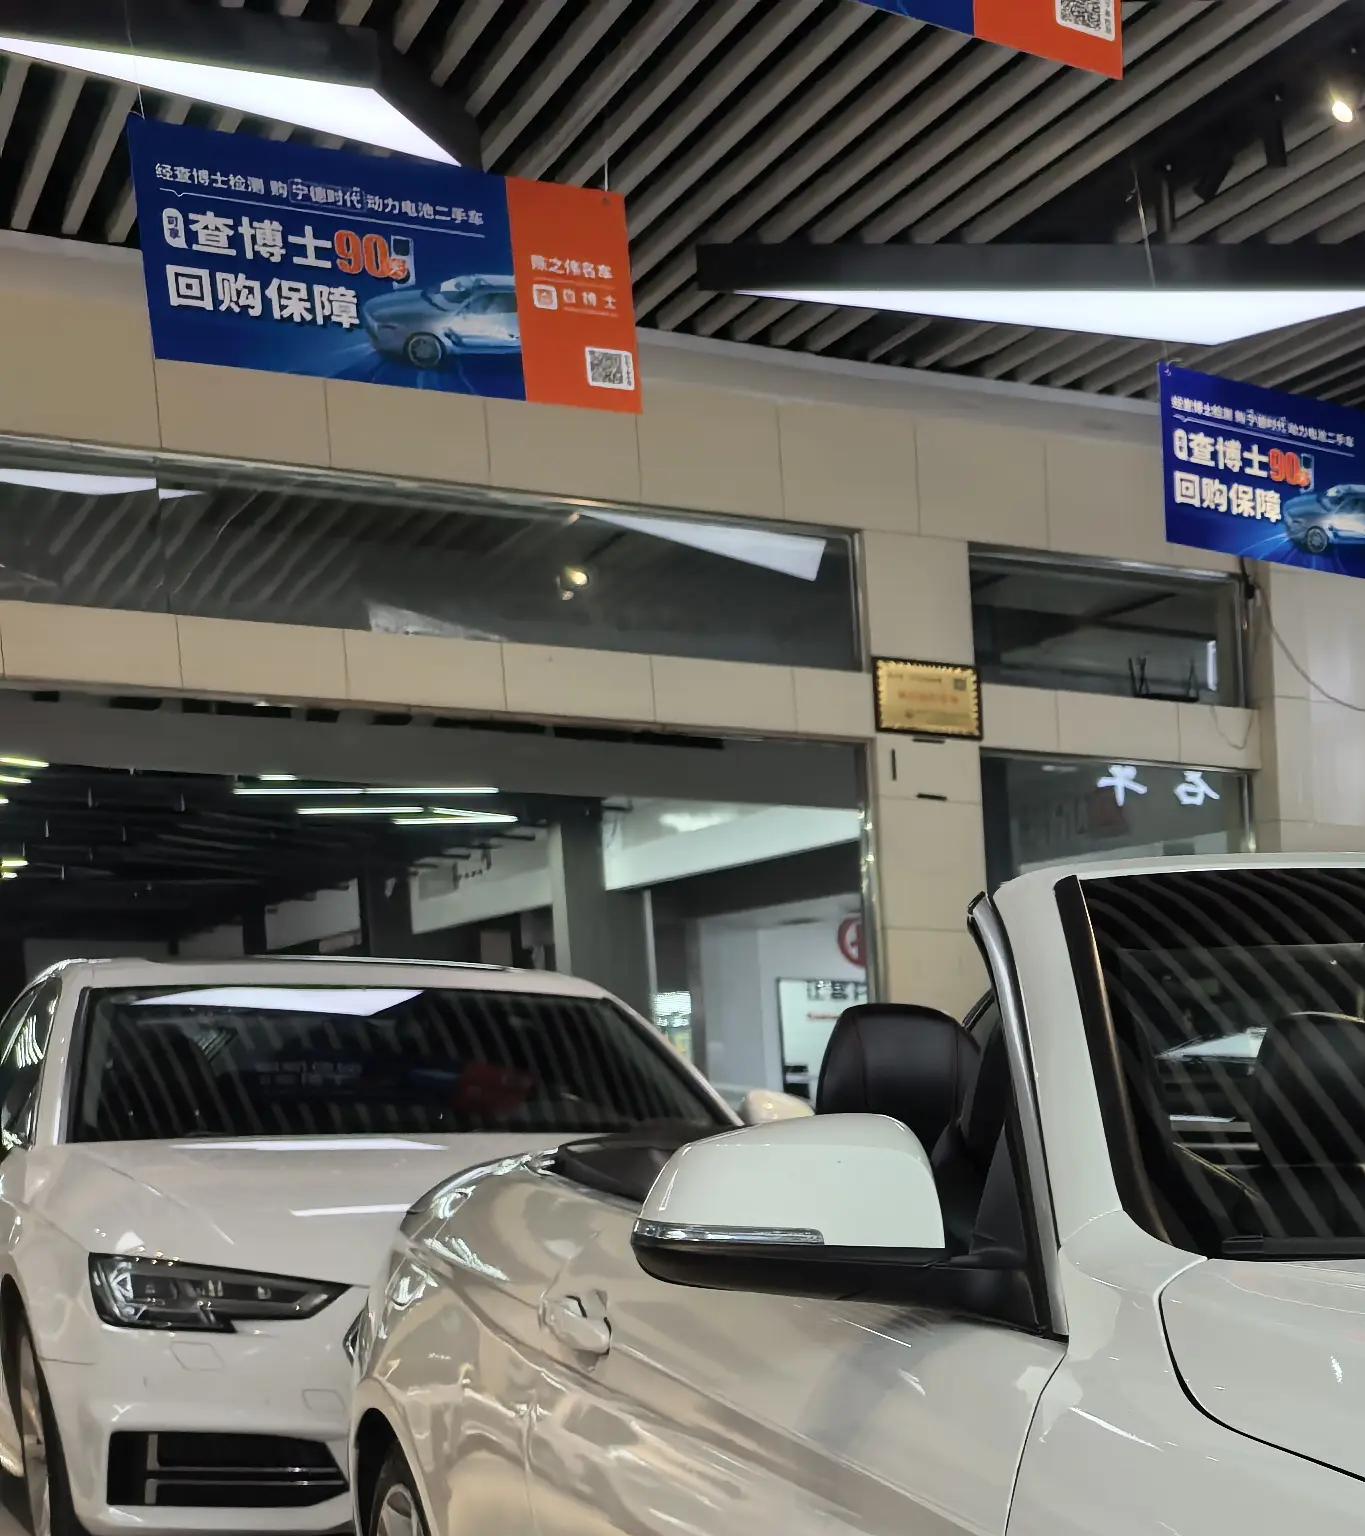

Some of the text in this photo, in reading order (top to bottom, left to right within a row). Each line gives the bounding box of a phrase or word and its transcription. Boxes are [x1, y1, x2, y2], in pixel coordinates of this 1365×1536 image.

[165, 264, 360, 329] 回购保障
[1173, 470, 1282, 523] 回购保障
